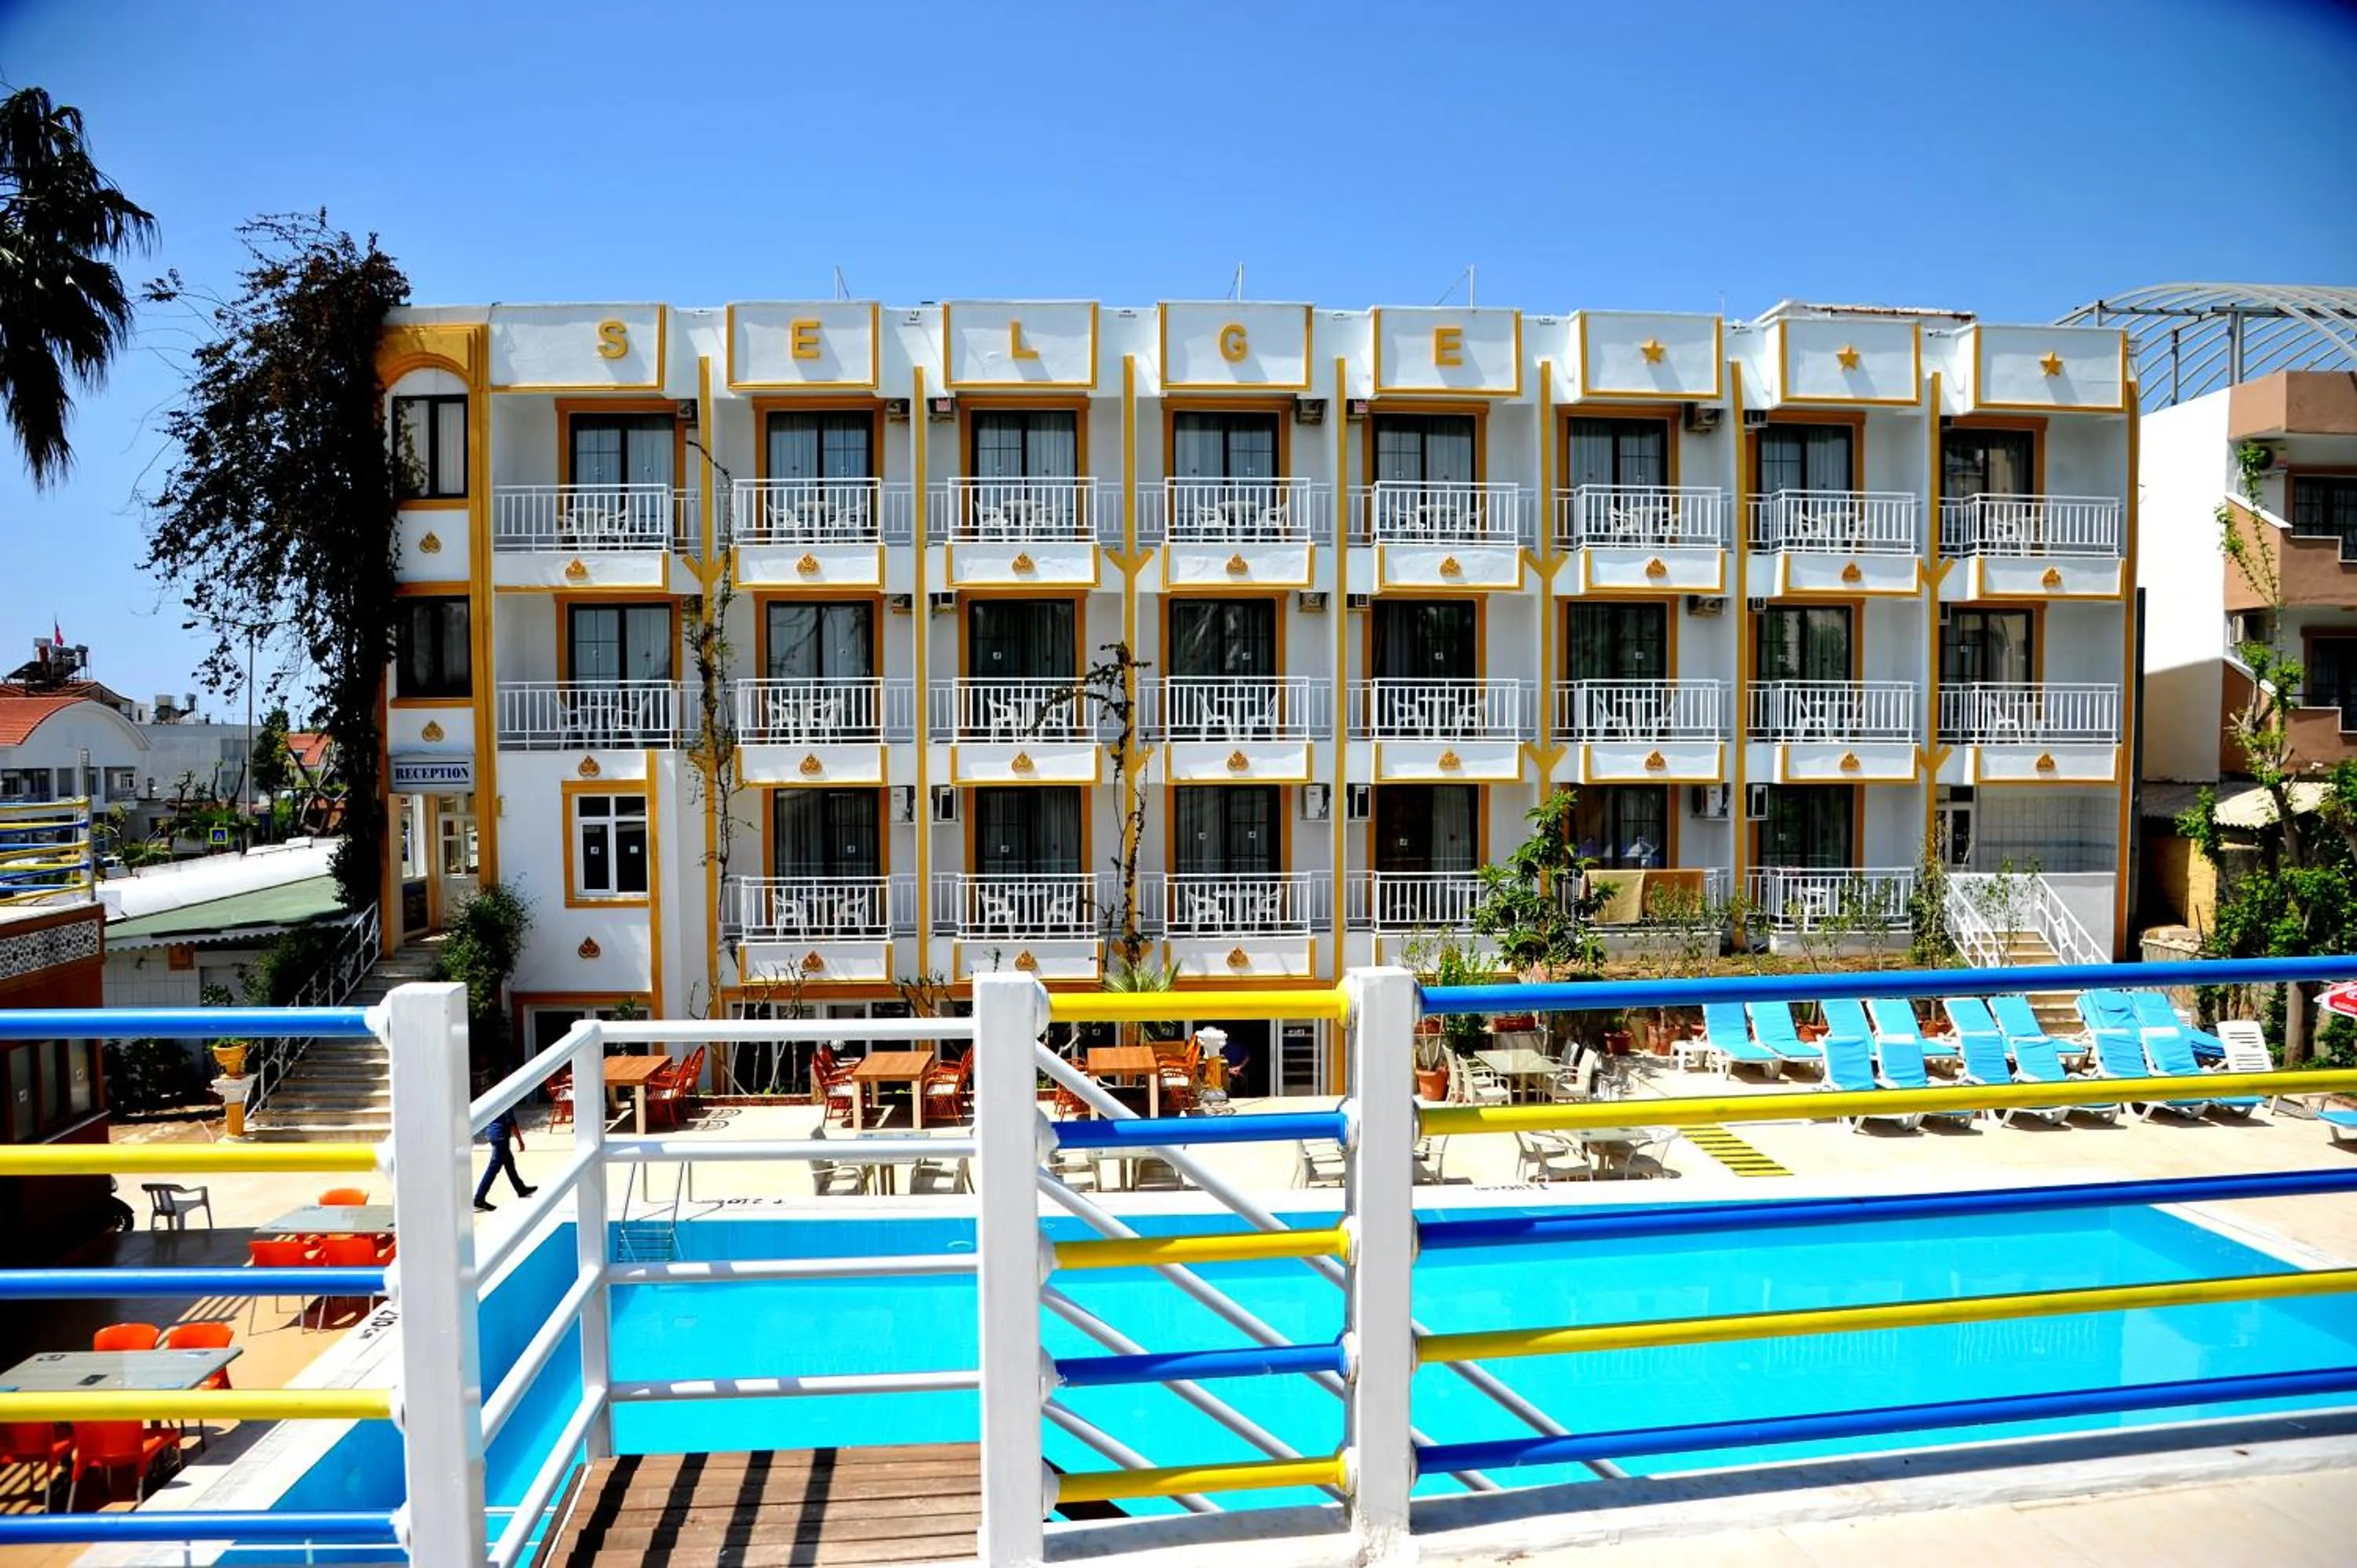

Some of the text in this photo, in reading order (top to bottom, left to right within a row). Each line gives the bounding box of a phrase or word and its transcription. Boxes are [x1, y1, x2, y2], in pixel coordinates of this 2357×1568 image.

[596, 319, 1462, 366] S E L G E
[394, 767, 470, 780] RECEPTION
